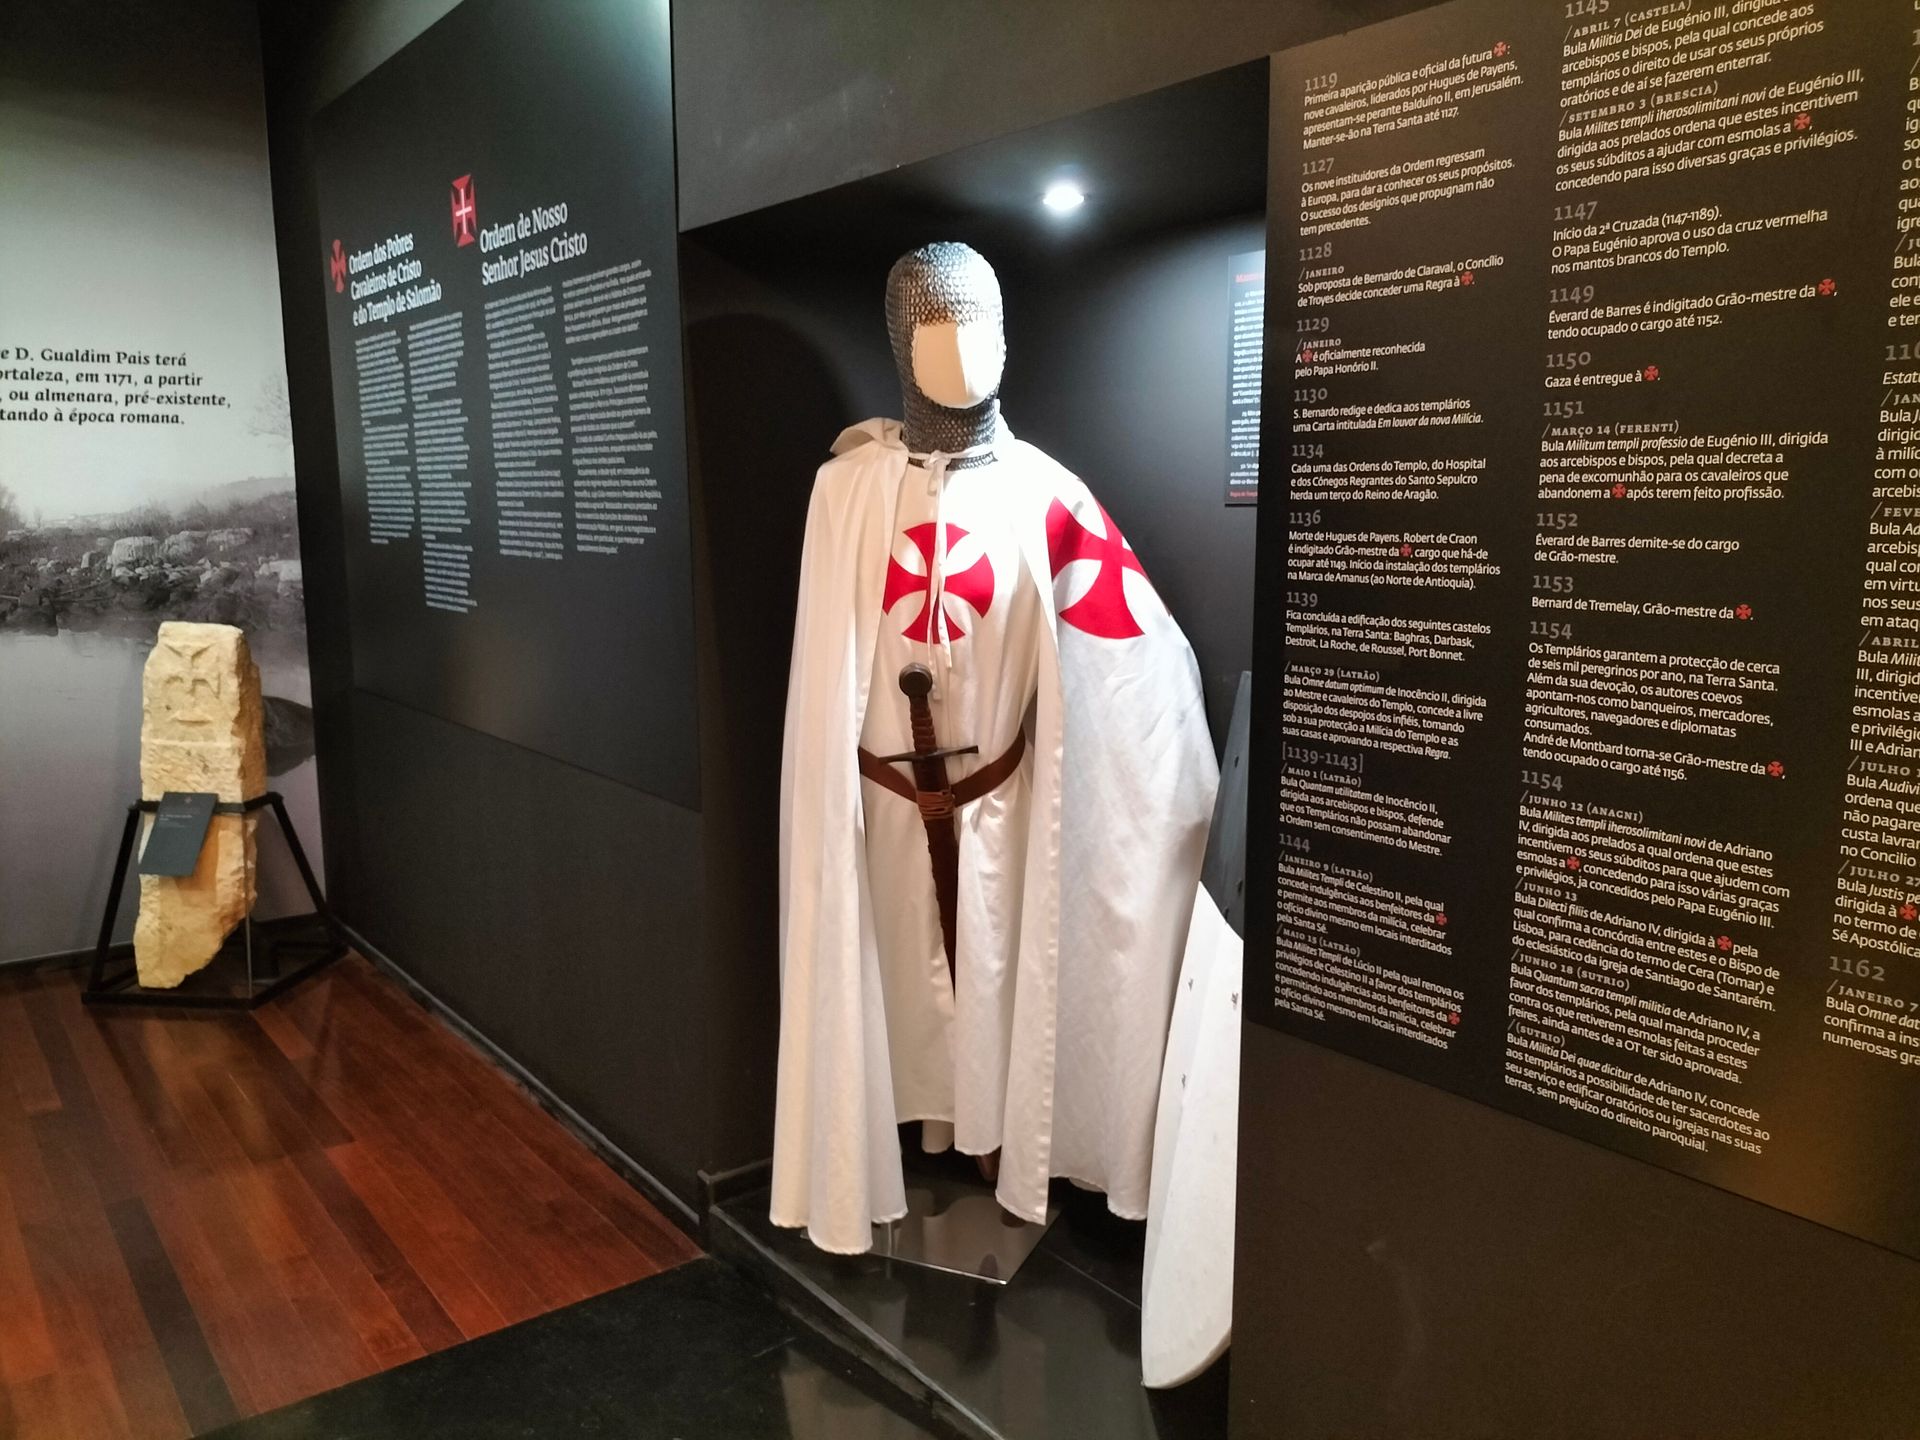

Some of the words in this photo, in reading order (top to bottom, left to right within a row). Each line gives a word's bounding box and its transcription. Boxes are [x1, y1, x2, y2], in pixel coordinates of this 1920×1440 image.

[1561, 50, 1620, 74] arcebispos
[1621, 48, 1629, 59] e
[1631, 39, 1672, 57] bispos,
[1674, 30, 1700, 50] pela
[1702, 21, 1730, 42] qual
[1732, 9, 1788, 33] concede
[1789, 3, 1814, 19] aos
[1303, 108, 1324, 121] nove
[1324, 97, 1369, 116] cavaleiros,
[1370, 86, 1410, 105] liderados
[1411, 82, 1428, 97] por
[1429, 73, 1465, 90] Hugues
[1466, 68, 1479, 81] de
[1480, 60, 1518, 77] Payens,
[1305, 72, 1338, 92] 1119
[1638, 98, 1646, 109] 3
[1303, 128, 1360, 150] Manter-se-ão
[1360, 126, 1372, 137] na
[1372, 121, 1395, 134] Terra
[1396, 114, 1423, 129] Santa
[1423, 108, 1440, 123] até
[1440, 106, 1459, 118] 1127.
[1302, 157, 1335, 175] 1127
[1555, 169, 1622, 191] concedendo
[1623, 166, 1650, 182] para
[1651, 161, 1675, 174] isso
[1676, 152, 1726, 170] diversas
[1728, 144, 1771, 164] graças
[1773, 142, 1782, 153] e
[1783, 129, 1857, 155] privilégios.
[1554, 200, 1598, 221] 1147
[480, 222, 516, 253] Ordem
[516, 212, 531, 239] de
[532, 202, 568, 234] Nosso
[1551, 246, 1562, 258] O
[1563, 243, 1590, 257] Papa
[1592, 235, 1638, 253] Eugénio
[1639, 231, 1680, 248] aprova
[1682, 229, 1691, 240] o
[1693, 226, 1715, 238] uso
[1717, 222, 1733, 235] da
[1735, 219, 1763, 232] cruz
[1764, 209, 1828, 228] vermelha
[349, 250, 373, 274] Ordem
[373, 243, 387, 265] dos
[386, 233, 414, 259] Pobres
[482, 255, 518, 286] Senhor
[519, 245, 549, 278] Jesus
[550, 231, 587, 263] Cristo
[1299, 241, 1332, 261] 1128
[1551, 262, 1571, 274] nos
[1572, 257, 1615, 271] mantos
[1616, 250, 1662, 266] brancos
[1663, 246, 1680, 260] do
[1680, 240, 1729, 257] Templo.
[351, 272, 387, 300] Cavaleiros
[387, 266, 397, 287] de
[397, 258, 421, 283] Cristo
[353, 311, 358, 326] e
[358, 304, 367, 324] do
[367, 295, 395, 322] Templo
[396, 291, 406, 313] de
[406, 278, 442, 310] Salomão
[1549, 284, 1594, 304] 1149
[1296, 316, 1329, 333] 1129
[15, 347, 34, 361] D.
[40, 348, 111, 364] Gualdim
[116, 351, 150, 365] Pais
[155, 352, 187, 366] terá
[1546, 351, 1591, 370] 1150
[75, 373, 99, 384] em
[105, 374, 138, 388] 1171,
[144, 374, 153, 385] a
[158, 373, 203, 388] partir
[1544, 376, 1571, 388] Gaza
[1573, 373, 1581, 386] é
[1581, 372, 1633, 386] entregue
[1634, 369, 1642, 382] à
[9, 390, 29, 401] ou
[35, 388, 119, 405] almenara,
[124, 391, 231, 408] pré-existente,
[1294, 387, 1328, 404] 1130
[54, 407, 63, 422] à
[69, 408, 115, 426] época
[120, 412, 185, 425] romana.
[1293, 408, 1301, 419] S.
[1302, 406, 1339, 418] Bernardo
[1339, 405, 1366, 418] redige
[1366, 405, 1373, 415] e
[1373, 402, 1402, 414] dedica
[1403, 402, 1419, 412] aos
[1420, 398, 1471, 412] templários
[1543, 400, 1584, 418] 1151
[1292, 443, 1324, 459] 1134
[1291, 463, 1312, 473] Cada
[1312, 464, 1332, 473] uma
[1332, 462, 1348, 472] das
[1348, 461, 1380, 472] Ordens
[1380, 460, 1393, 471] do
[1393, 459, 1430, 473] Templo,
[1431, 458, 1444, 470] do
[1445, 457, 1486, 472] Hospital
[1289, 509, 1321, 527] 1136
[1536, 512, 1578, 530] 1152
[1535, 532, 1575, 546] Éverard
[1576, 534, 1590, 547] de
[1591, 535, 1626, 548] Barres
[1627, 536, 1686, 549] demite-se
[1687, 537, 1703, 550] do
[1704, 540, 1740, 553] cargo
[1534, 549, 1547, 561] de
[1548, 550, 1619, 564] Grão-mestre.
[1532, 575, 1573, 593] 1153
[1286, 591, 1318, 607] 1139
[1286, 609, 1301, 620] Fica
[1302, 611, 1340, 623] concluída
[1340, 615, 1347, 623] a
[1347, 614, 1390, 628] edificação
[1390, 616, 1407, 628] dos
[1407, 619, 1452, 632] seguintes
[1452, 622, 1491, 634] castelos
[1530, 621, 1572, 640] 1154
[1525, 703, 1588, 721] agricultores,
[1590, 711, 1660, 728] navegadores
[1661, 719, 1669, 729] e
[1670, 718, 1737, 738] diplomatas
[1282, 741, 1363, 773] [1139-1143]
[1521, 770, 1563, 792] 1154
[1279, 833, 1310, 853] 1144
[1839, 845, 1858, 857] no
[1860, 847, 1917, 867] Concilio
[1834, 894, 1886, 915] dirigida
[1887, 904, 1897, 918] à
[1831, 928, 1848, 942] Sé
[1833, 913, 1852, 925] no
[1853, 916, 1897, 935] termo
[1899, 925, 1917, 939] de
[1829, 955, 1884, 981] 1162
[1822, 1031, 1898, 1059] numerosas
[1504, 1074, 1535, 1094] terras,
[1536, 1086, 1558, 1100] sem
[1558, 1094, 1599, 1115] prejuízo
[1600, 1107, 1615, 1120] do
[1615, 1112, 1651, 1132] direito
[1651, 1125, 1708, 1152] paroquial.
